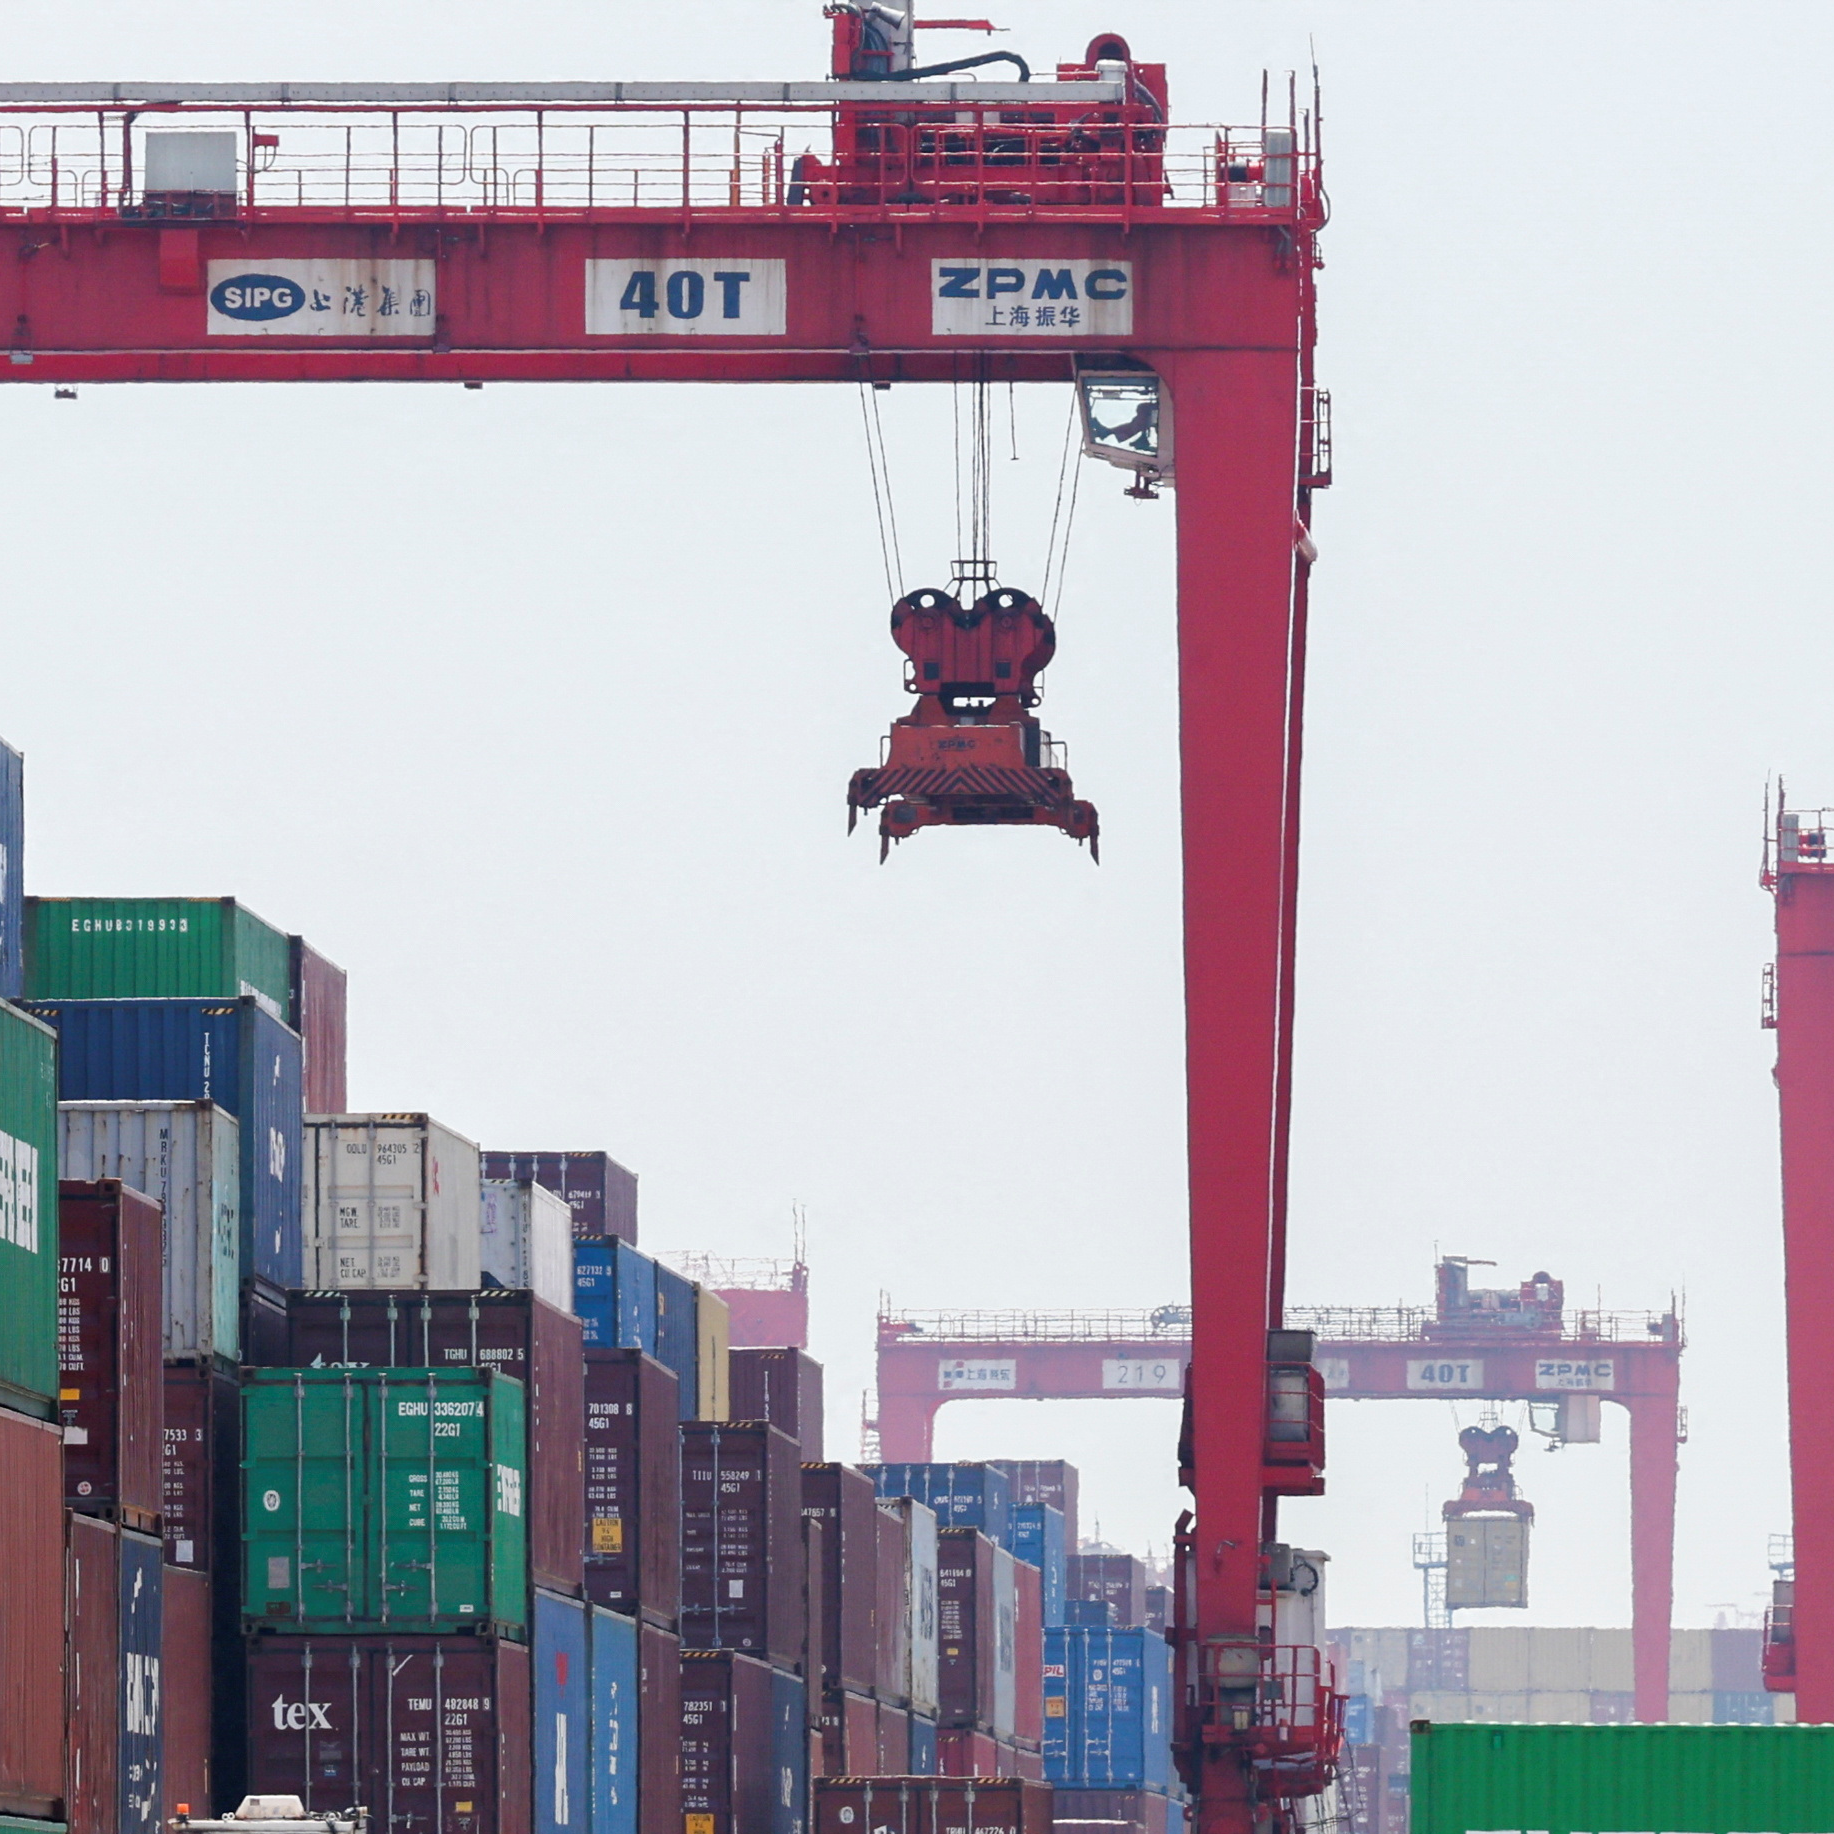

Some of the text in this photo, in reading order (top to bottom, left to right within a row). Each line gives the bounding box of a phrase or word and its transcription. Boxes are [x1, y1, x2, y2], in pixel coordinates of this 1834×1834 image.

[938, 267, 1128, 300] ZPMC
[224, 287, 293, 309] SIPG
[619, 269, 751, 321] 40T
[985, 305, 1081, 328] 上海振华
[377, 1143, 407, 1154] 964305
[377, 1155, 397, 1165] 45G1
[444, 1348, 513, 1360] TGHU 688802
[1117, 1364, 1167, 1384] 219
[1420, 1364, 1471, 1383] 40T
[1538, 1363, 1611, 1377] ZPMC
[398, 1401, 428, 1417] EGHU
[588, 1402, 619, 1415] 701308
[588, 1417, 609, 1429] 45G1
[434, 1422, 461, 1437] 22G1
[720, 1470, 750, 1481] 558249
[720, 1483, 740, 1493] 45G1
[407, 1698, 479, 1710] TEMU 482848
[684, 1701, 713, 1712] 782351
[445, 1713, 467, 1725] 22G1
[683, 1714, 703, 1725] 45G1
